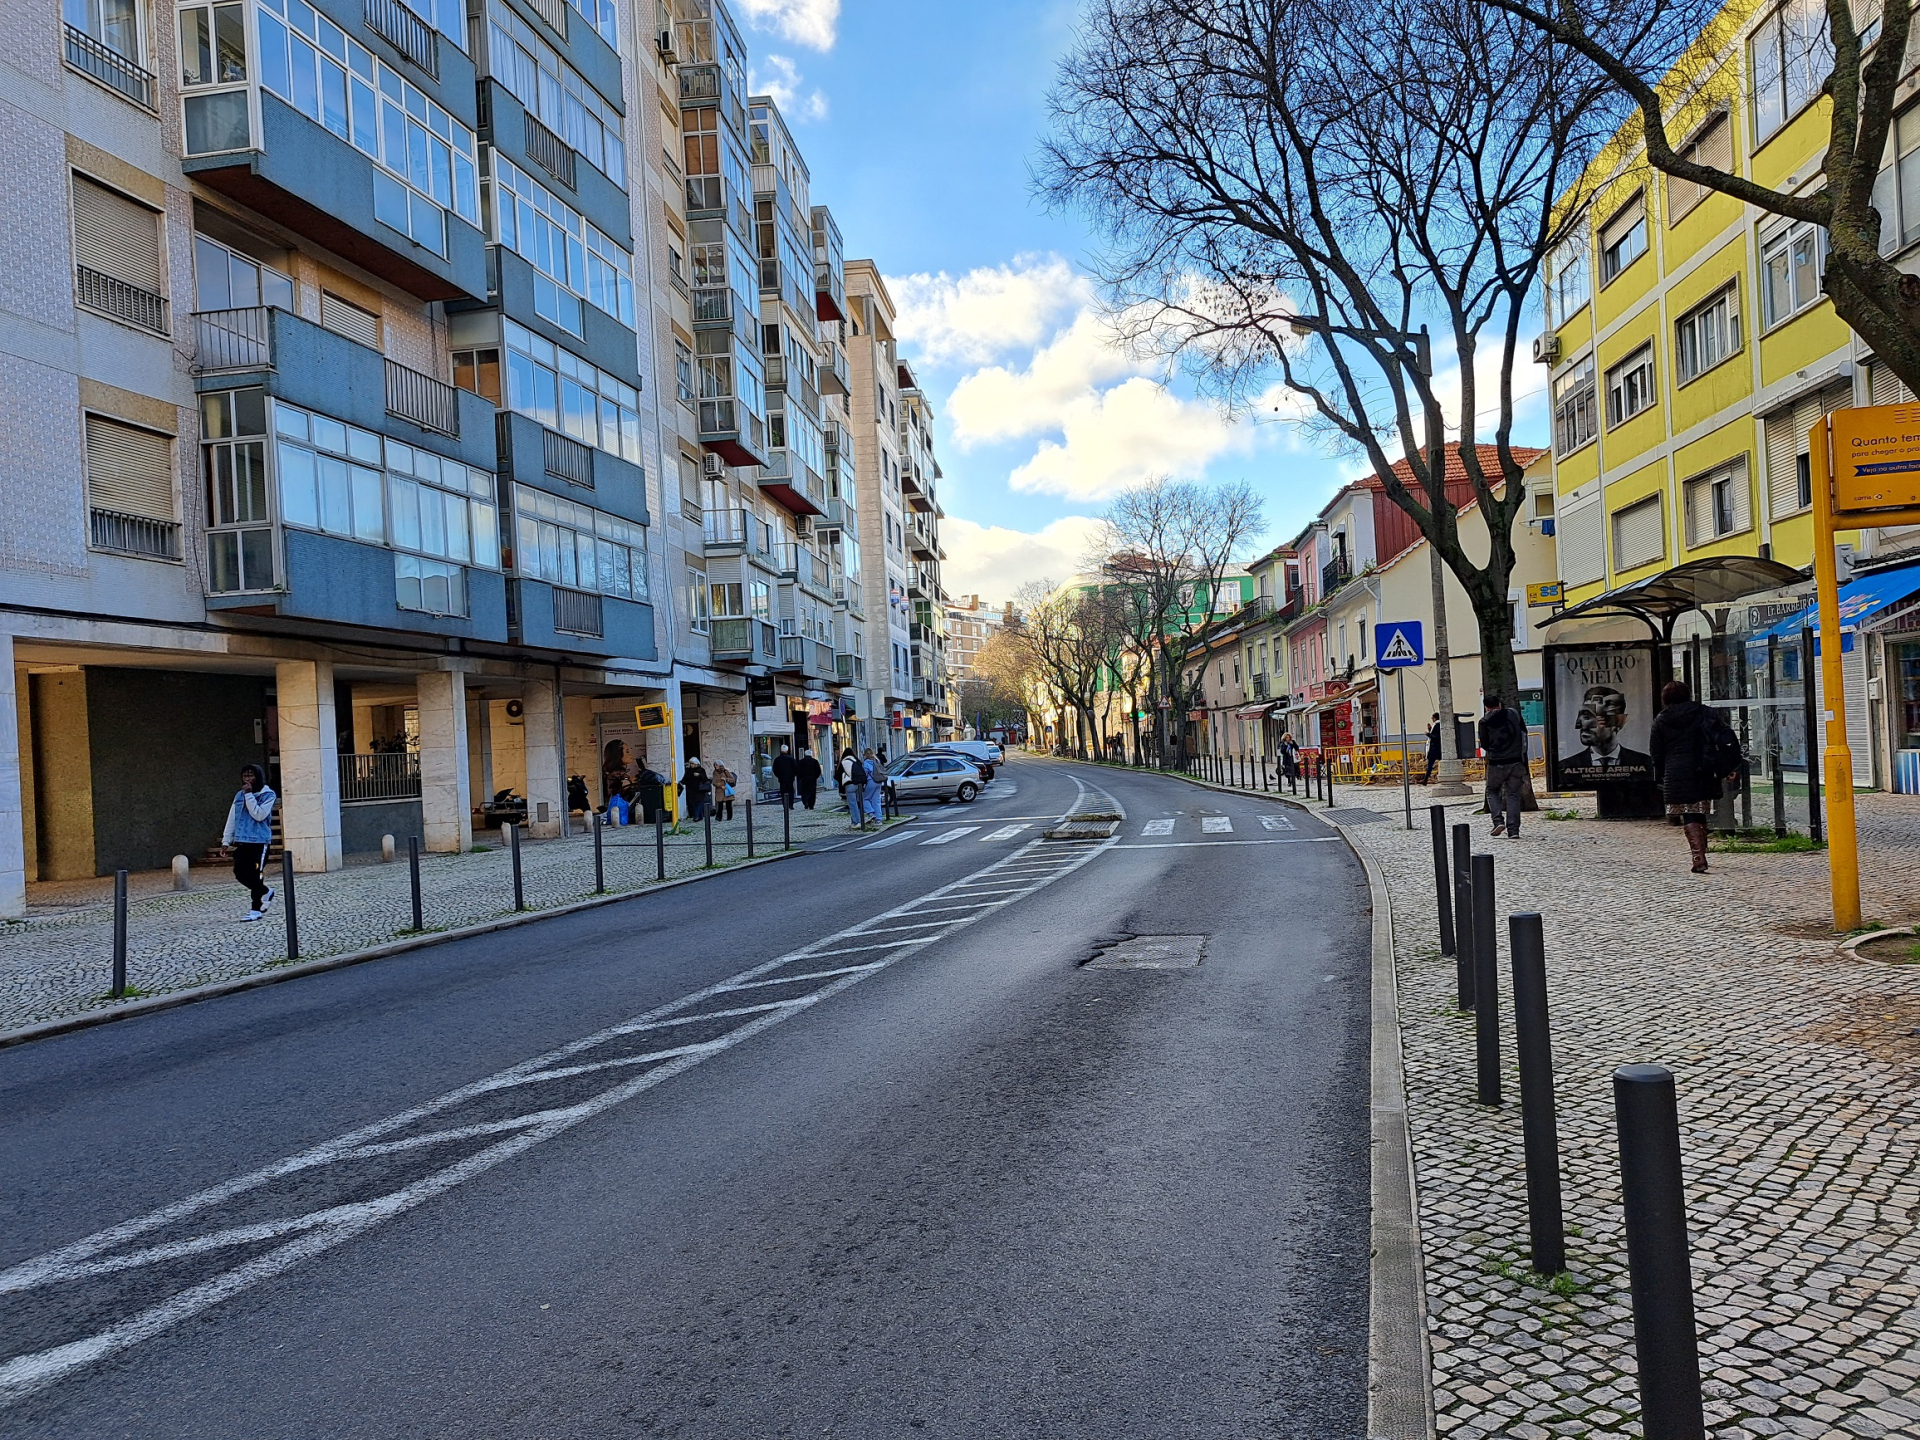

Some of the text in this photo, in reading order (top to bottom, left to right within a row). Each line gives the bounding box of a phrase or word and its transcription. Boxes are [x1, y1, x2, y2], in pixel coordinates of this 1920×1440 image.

[1851, 436, 1898, 447] Quanto
[1871, 448, 1898, 456] chegar
[1567, 655, 1636, 674] QUATRO
[1581, 670, 1624, 684] MEIA
[1607, 765, 1646, 773] ARENA
